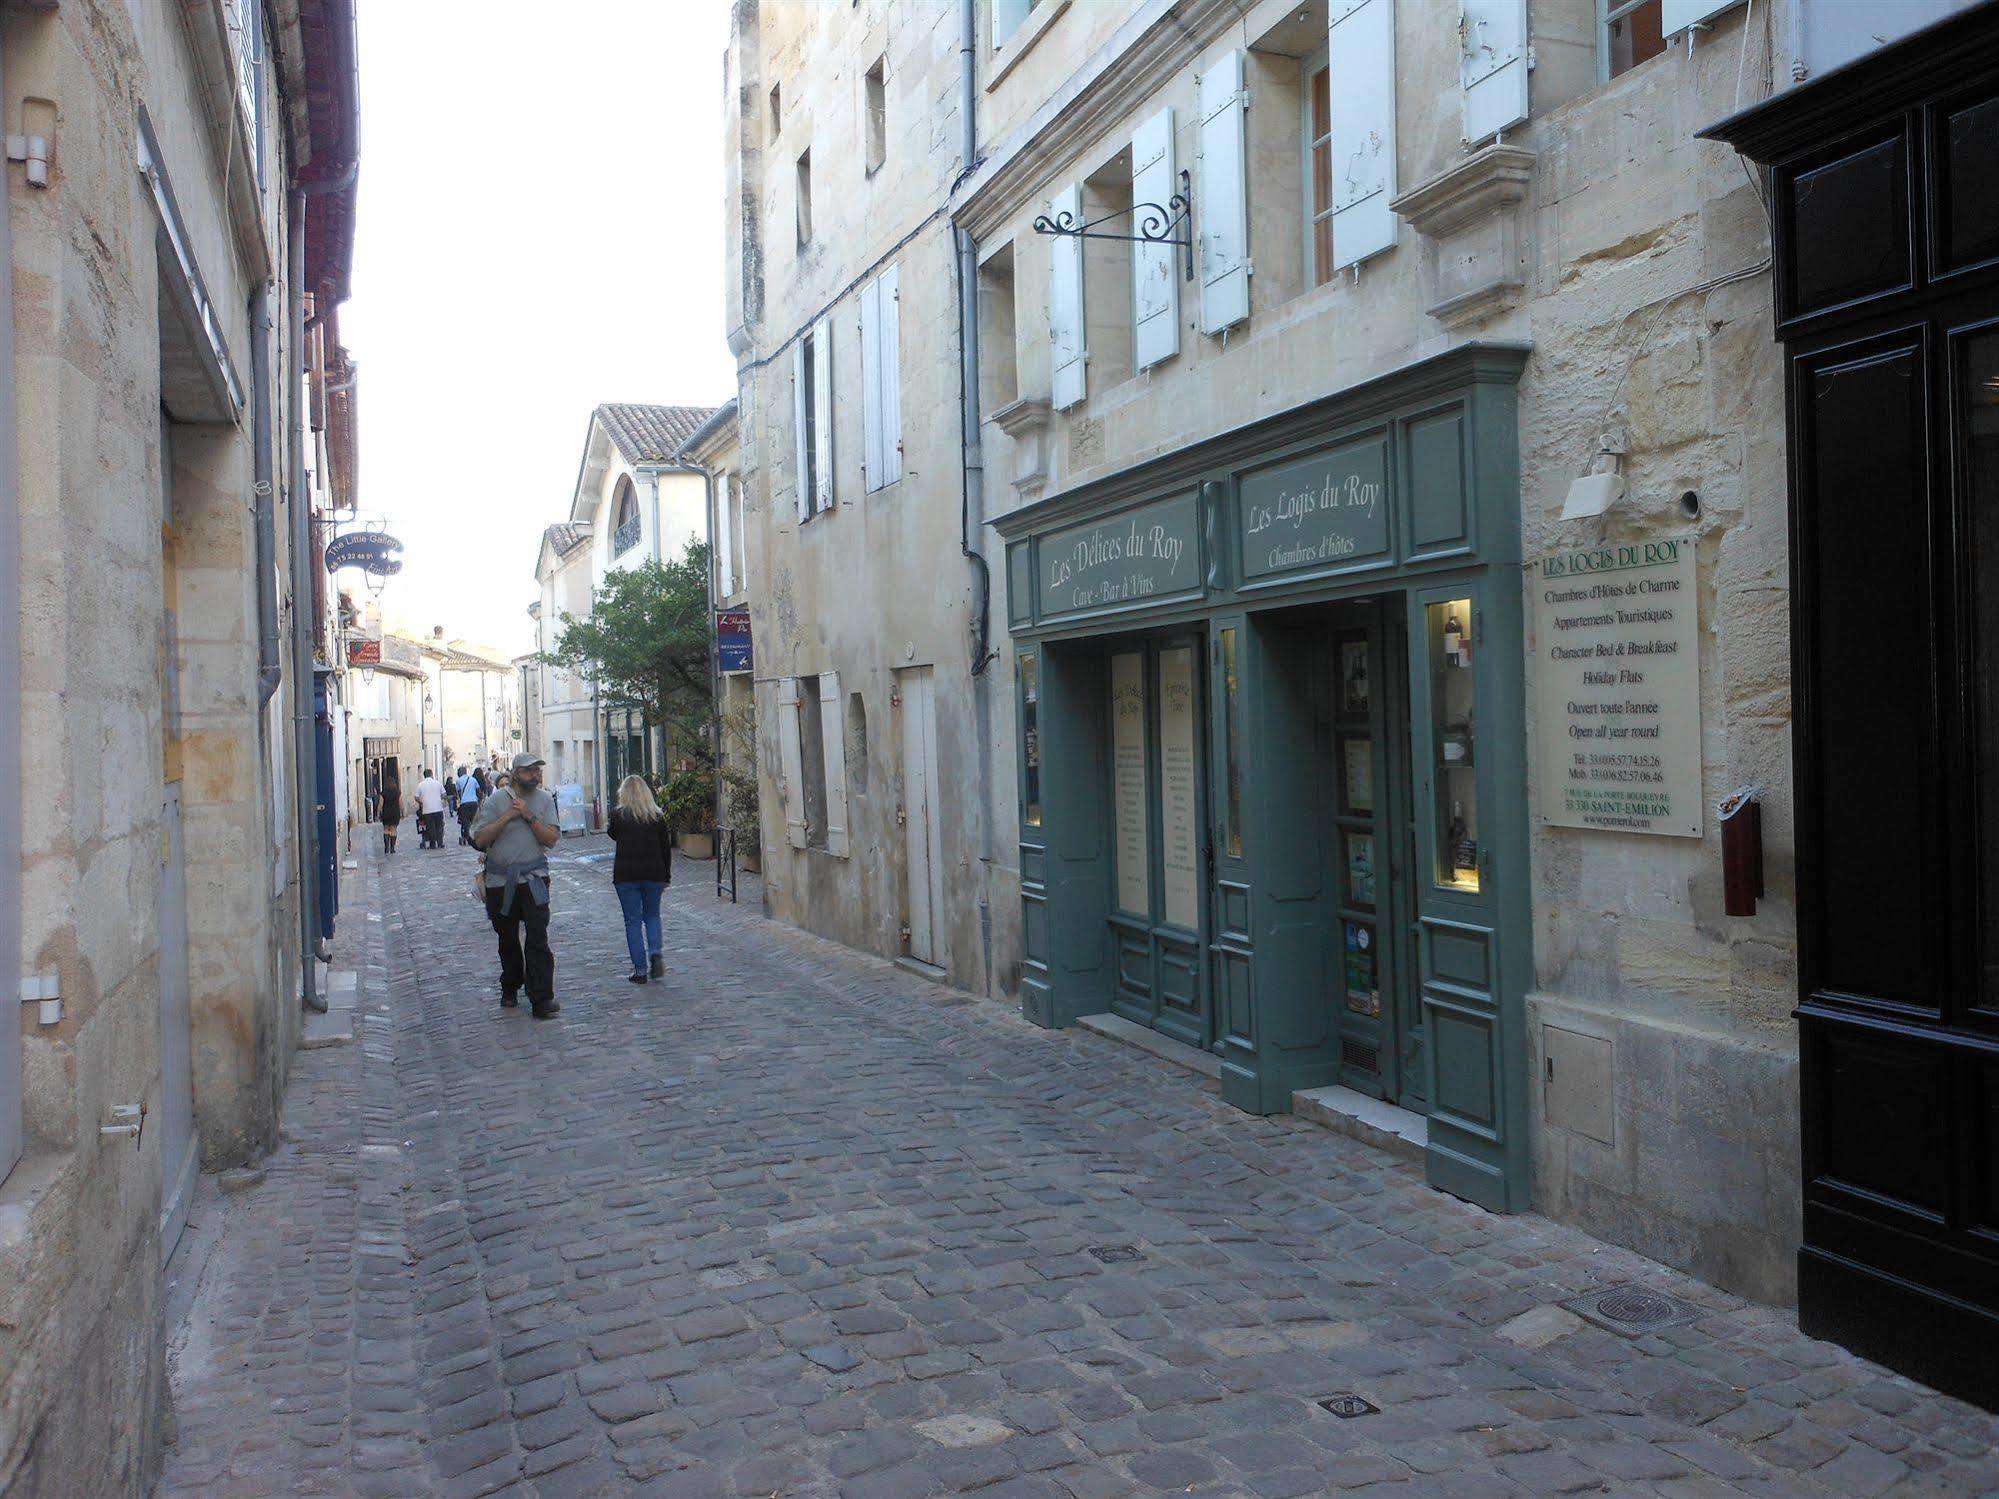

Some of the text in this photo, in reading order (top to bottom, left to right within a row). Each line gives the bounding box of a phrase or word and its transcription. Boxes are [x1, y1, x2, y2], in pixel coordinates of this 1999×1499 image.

[1247, 473, 1379, 535] Les Logis du Roy
[328, 534, 401, 556] The Little Gallery
[1049, 519, 1183, 592] Les Délices du Roy
[1268, 532, 1355, 569] Chambres d'hôtes
[347, 552, 356, 561] 22
[1543, 539, 1680, 577] LES LOGIS DU ROY
[1072, 586, 1093, 607] Cave
[1100, 580, 1120, 602] Bar
[1122, 577, 1128, 597] à
[1130, 573, 1154, 596] Vins
[1544, 579, 1680, 604] Chambres d'Hôtes de Charme
[1553, 608, 1673, 631] Appartements Touristiques
[1551, 646, 1593, 660] Character
[1595, 643, 1614, 657] Bed
[1615, 644, 1625, 656] &
[1583, 669, 1643, 686] Holiday Flats
[1567, 700, 1658, 714] Ouvert toute l'année
[1569, 724, 1659, 740] Open all year round
[1583, 790, 1592, 798] DE
[1603, 791, 1625, 799] PORTE
[1591, 800, 1671, 816] SAINT-EMILION
